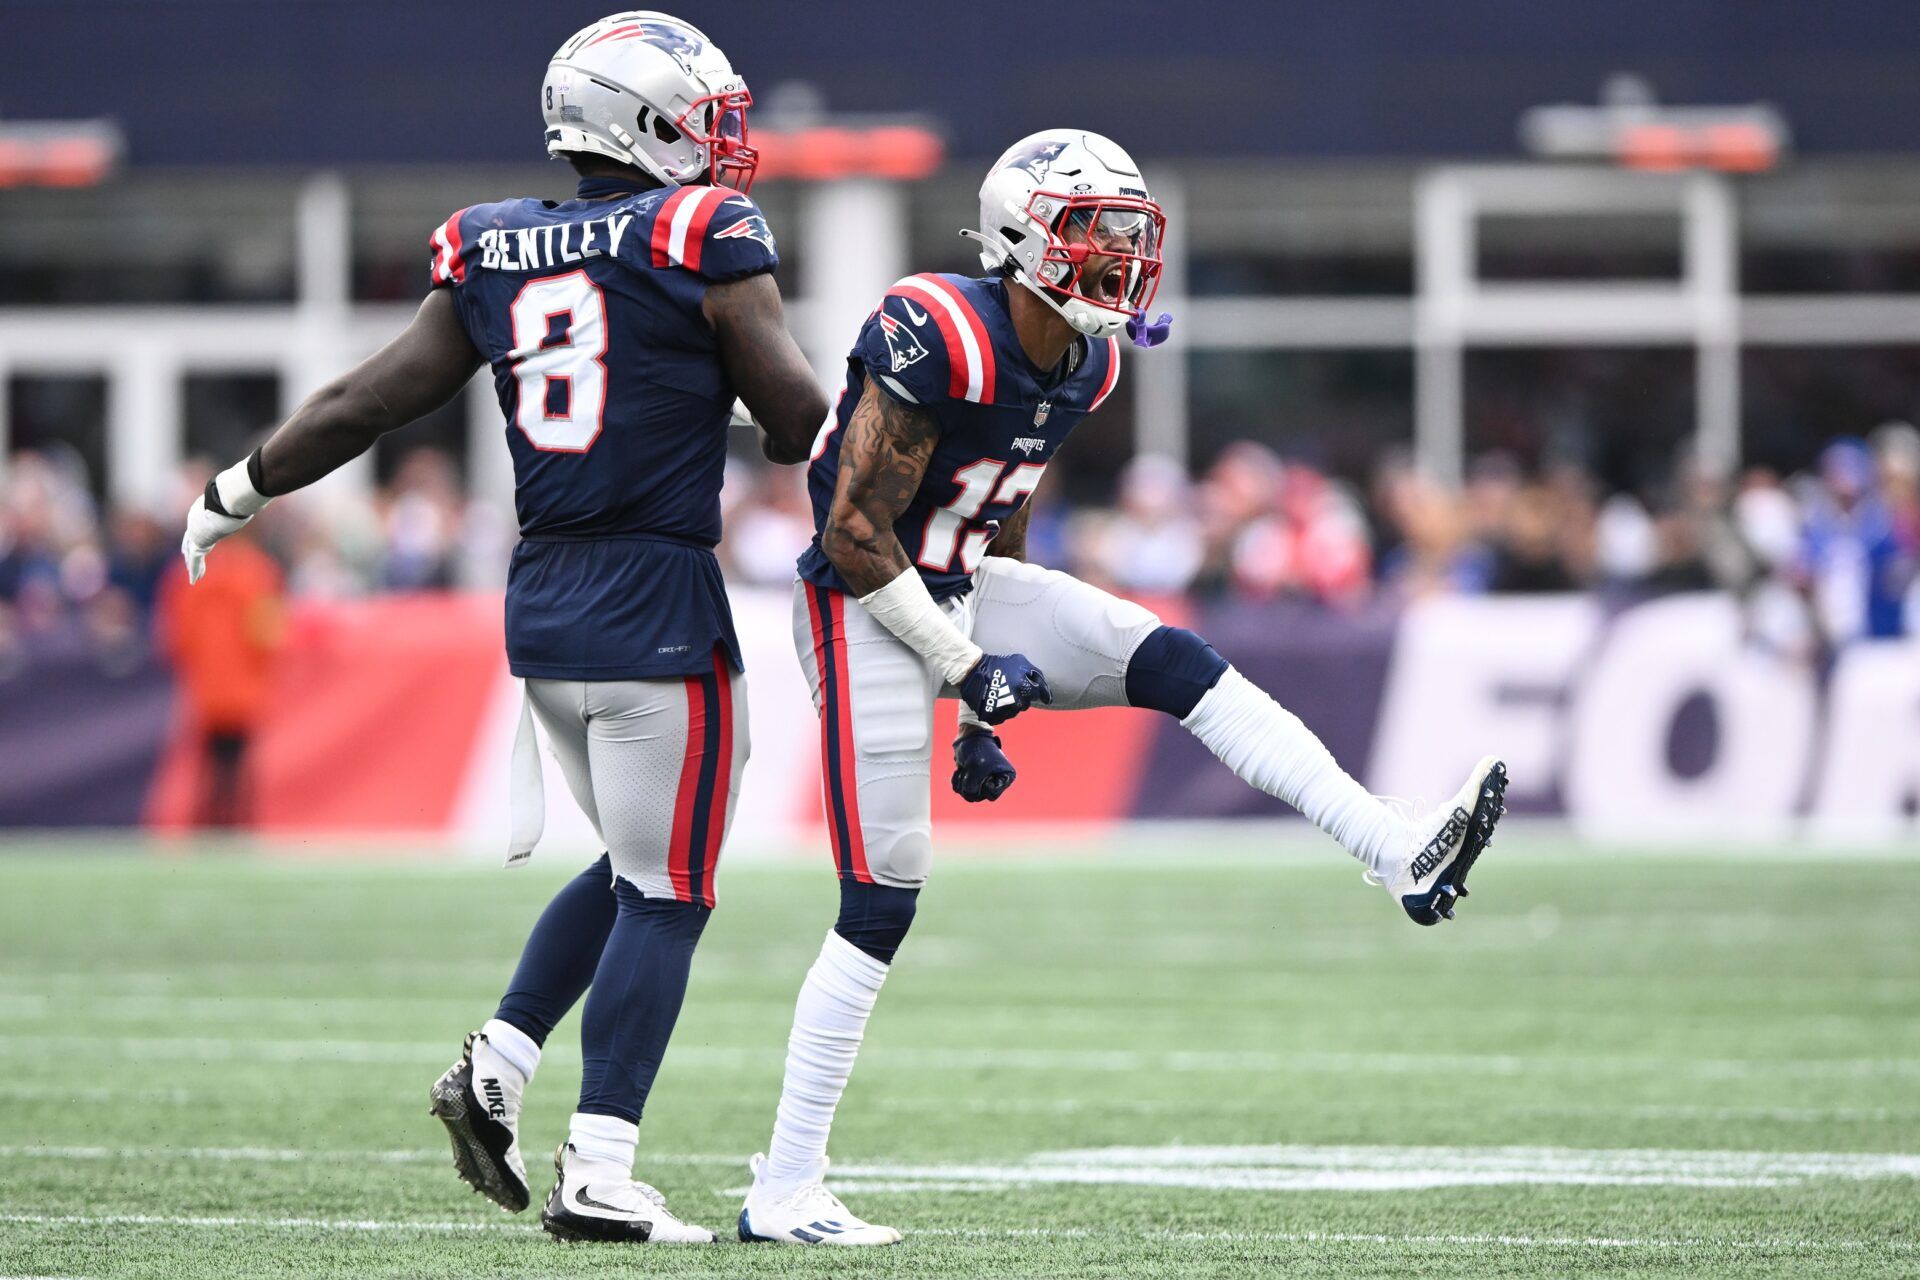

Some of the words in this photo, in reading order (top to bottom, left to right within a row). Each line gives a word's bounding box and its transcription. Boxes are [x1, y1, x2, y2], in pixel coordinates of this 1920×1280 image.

[546, 85, 553, 110] 8
[479, 214, 634, 271] BENTLEY
[508, 269, 609, 453] 8
[1011, 437, 1046, 451] PATRIOTS
[985, 668, 1002, 713] adidas
[1410, 806, 1471, 885] ADIZERO
[480, 1078, 506, 1119] NIKE
